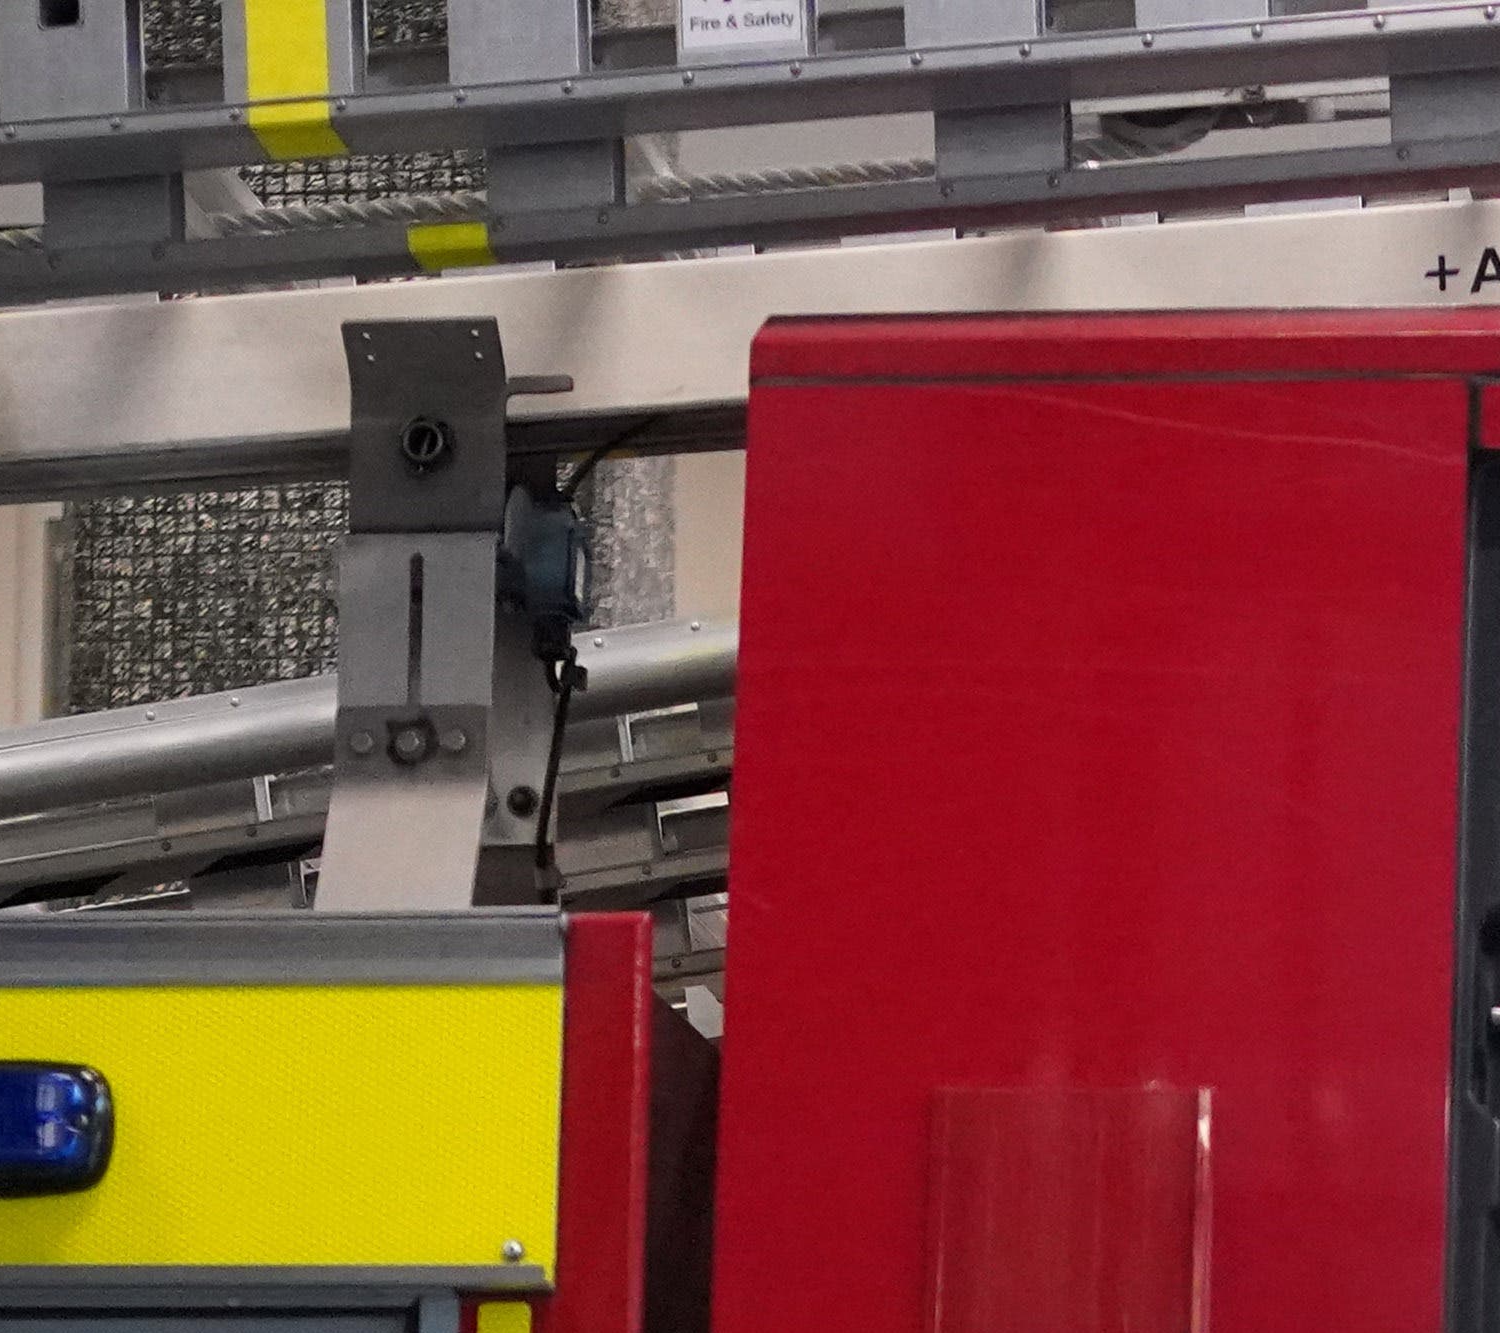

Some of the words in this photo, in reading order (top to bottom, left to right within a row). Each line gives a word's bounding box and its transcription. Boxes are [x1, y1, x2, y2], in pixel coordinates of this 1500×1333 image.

[689, 15, 722, 30] Fire
[726, 14, 738, 29] &
[743, 11, 795, 28] Safety
